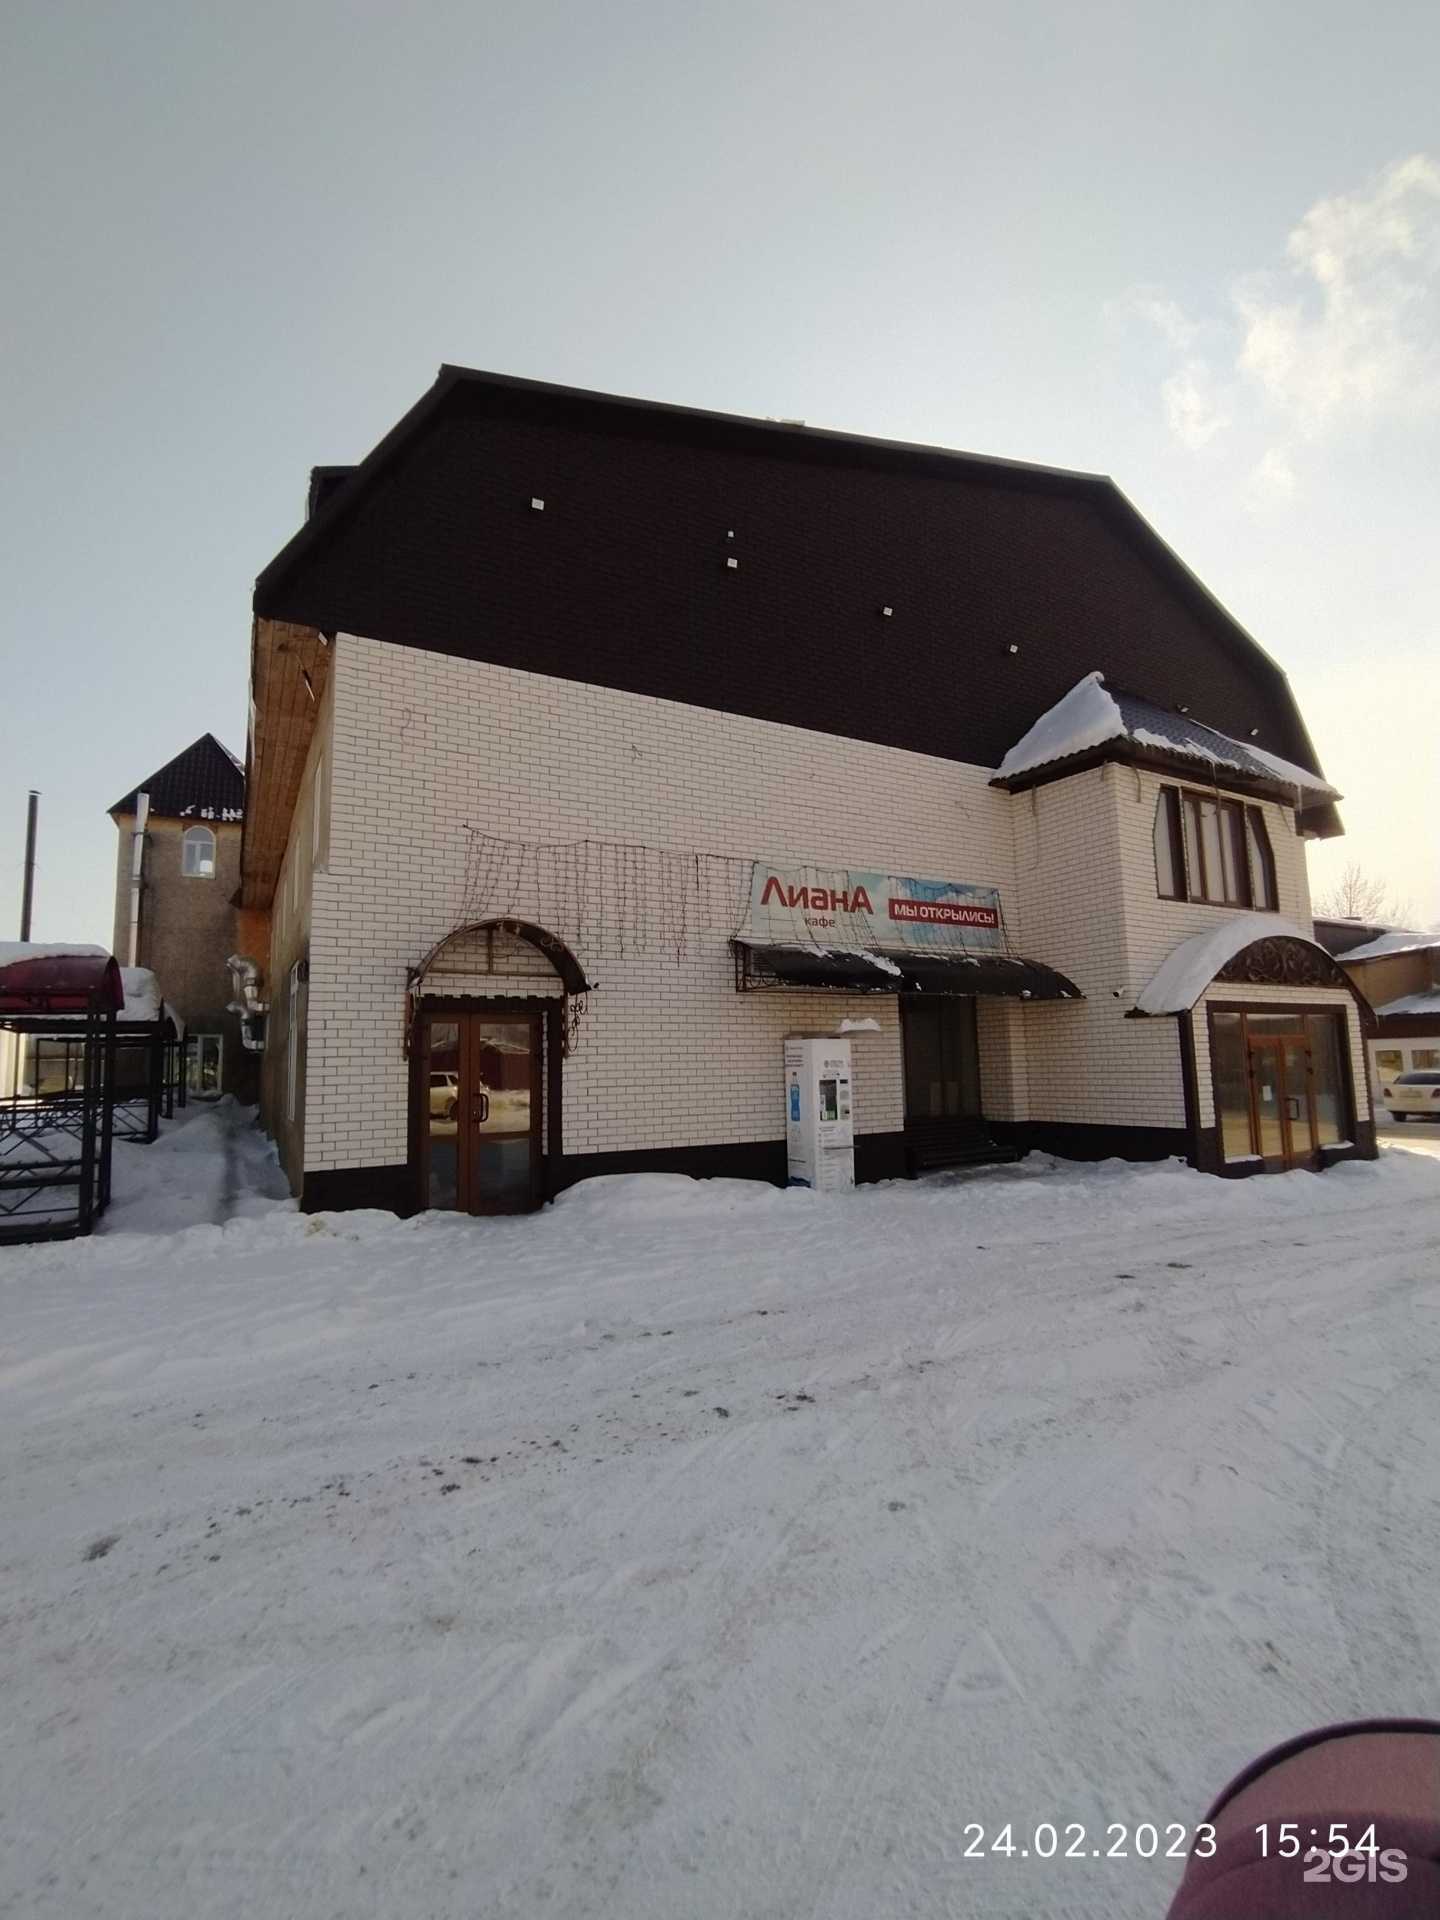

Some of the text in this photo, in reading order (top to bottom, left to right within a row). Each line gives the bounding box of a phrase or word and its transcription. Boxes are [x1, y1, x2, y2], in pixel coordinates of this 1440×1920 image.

[894, 903, 995, 924] МЫ ОТКРЫЛИСЬ!
[804, 917, 836, 929] кафе
